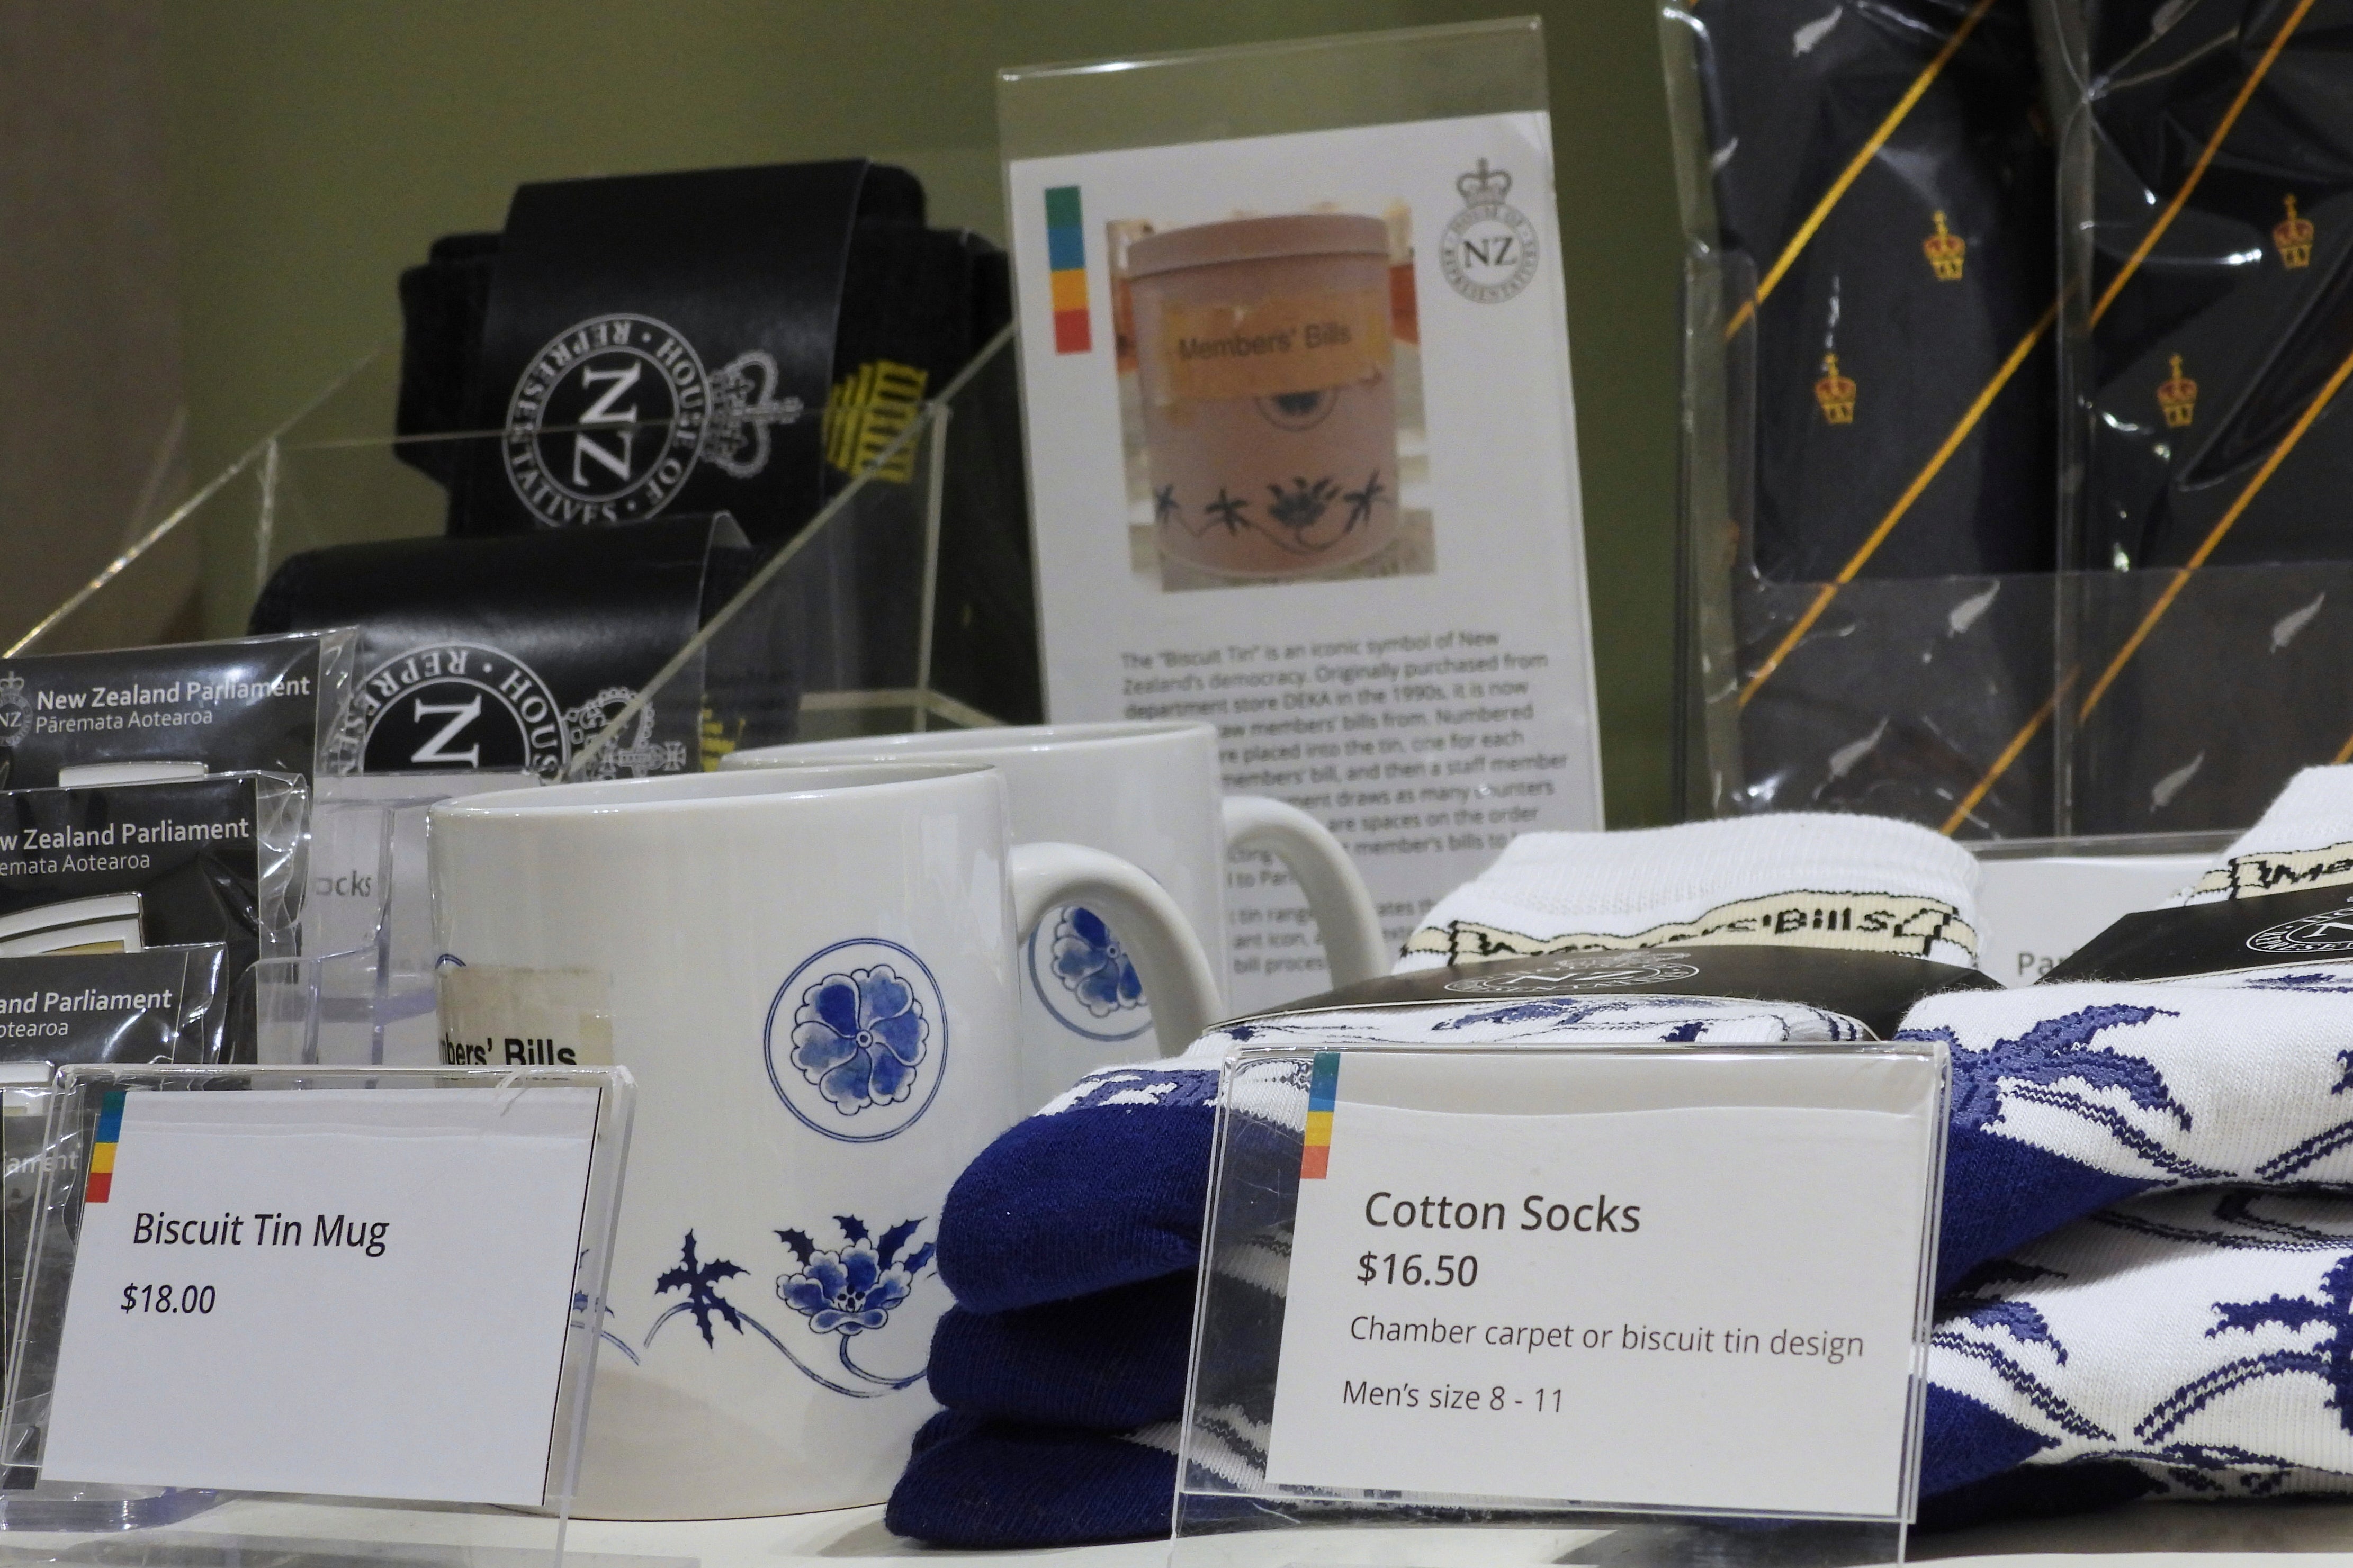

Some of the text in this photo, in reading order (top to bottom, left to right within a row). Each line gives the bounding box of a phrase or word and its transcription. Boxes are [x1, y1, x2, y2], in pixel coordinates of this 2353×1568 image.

[1463, 237, 1518, 268] NZ
[1178, 321, 1352, 359] Members' Bills
[656, 337, 704, 449] HOUSE
[573, 359, 642, 487] NZ
[1121, 651, 1154, 669] The
[1265, 645, 1280, 661] is
[1283, 645, 1306, 660] an
[1310, 640, 1360, 657] iconic
[1366, 634, 1431, 657] symbol
[1434, 630, 1453, 650] of
[1458, 632, 1499, 647] New
[1123, 652, 1548, 696] Zealand's democracy. Originally purchased from
[37, 676, 310, 711] New Zealand Parliament
[1124, 698, 1227, 720] department
[1233, 697, 1278, 713] store
[1283, 690, 1330, 710] DEKA
[1335, 690, 1353, 705] in
[1357, 687, 1387, 705] the
[1468, 682, 1485, 698] is
[1488, 681, 1529, 696] now
[35, 709, 213, 734] Pāremata Aotearoa
[1219, 701, 1534, 738] aw members' bills from. Numbered
[1219, 747, 1239, 764] re
[1242, 742, 1301, 765] placed
[1305, 741, 1341, 758] into
[1344, 739, 1375, 756] the
[1411, 735, 1447, 753] one
[1449, 731, 1476, 750] for
[1481, 728, 1525, 748] each
[1346, 762, 1381, 781] and
[1383, 760, 1426, 779] then
[1431, 763, 1442, 777] a
[1447, 754, 1486, 776] staff
[1489, 752, 1568, 772] member
[1336, 789, 1391, 808] draws
[1396, 789, 1416, 804] as
[1420, 787, 1470, 806] many
[23, 822, 115, 850] Zealand
[122, 817, 249, 844] Parliament
[1360, 813, 1422, 832] spaces
[1425, 812, 1450, 827] on
[1453, 808, 1483, 825] the
[1488, 804, 1539, 824] order
[1354, 835, 1444, 855] member's
[1447, 832, 1483, 852] bills
[1488, 833, 1509, 850] to
[0, 853, 150, 876] emata Aotearoa
[315, 870, 371, 897] ocks
[1264, 953, 1324, 976] proces
[43, 988, 173, 1013] Parliament
[0, 1021, 69, 1039] otearoa
[1364, 1191, 1642, 1234] Cotton Socks
[133, 1211, 390, 1258] Biscuit Tin Mug
[1357, 1250, 1479, 1287] $16.50
[120, 1283, 217, 1314] $18.00
[1350, 1315, 1864, 1365] Chamber carpet or biscuit tin design
[1342, 1380, 1420, 1408] Men's
[1429, 1384, 1481, 1410] size
[1489, 1385, 1506, 1411] 8
[1535, 1387, 1563, 1413] 11
